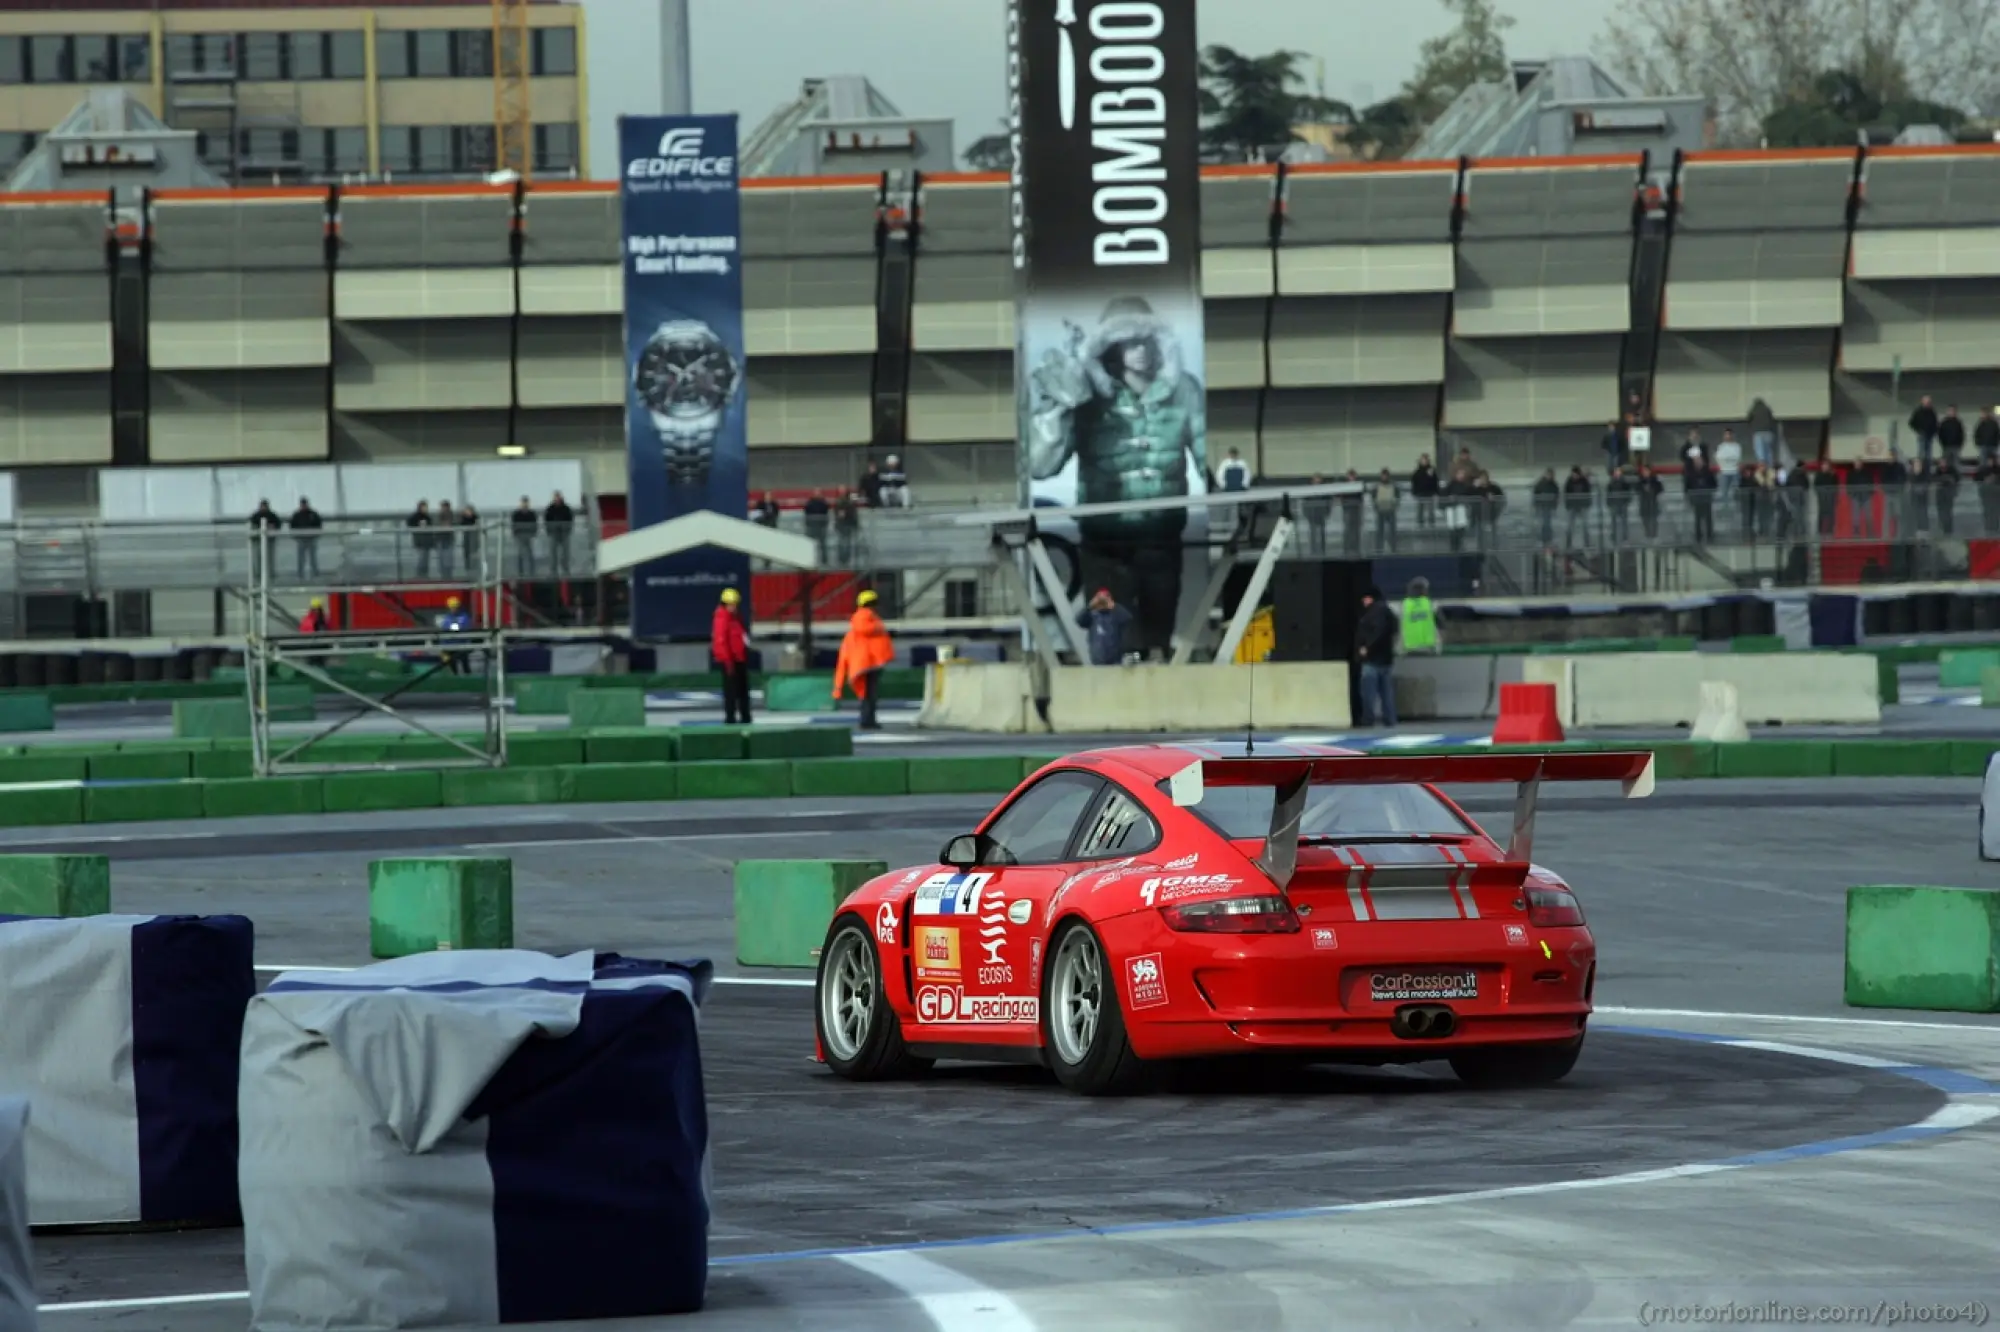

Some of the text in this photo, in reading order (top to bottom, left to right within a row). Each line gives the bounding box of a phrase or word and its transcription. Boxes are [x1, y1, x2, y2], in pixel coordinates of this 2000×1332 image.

[1089, 2, 1169, 266] BOMBOO
[627, 157, 735, 178] EDIFICE
[1162, 874, 1229, 887] GMS
[962, 877, 981, 912] 4
[978, 965, 1013, 985] ECOSYS
[1371, 972, 1476, 990] CarPassion.it
[1372, 990, 1395, 1000] News
[1410, 989, 1441, 999] mondo
